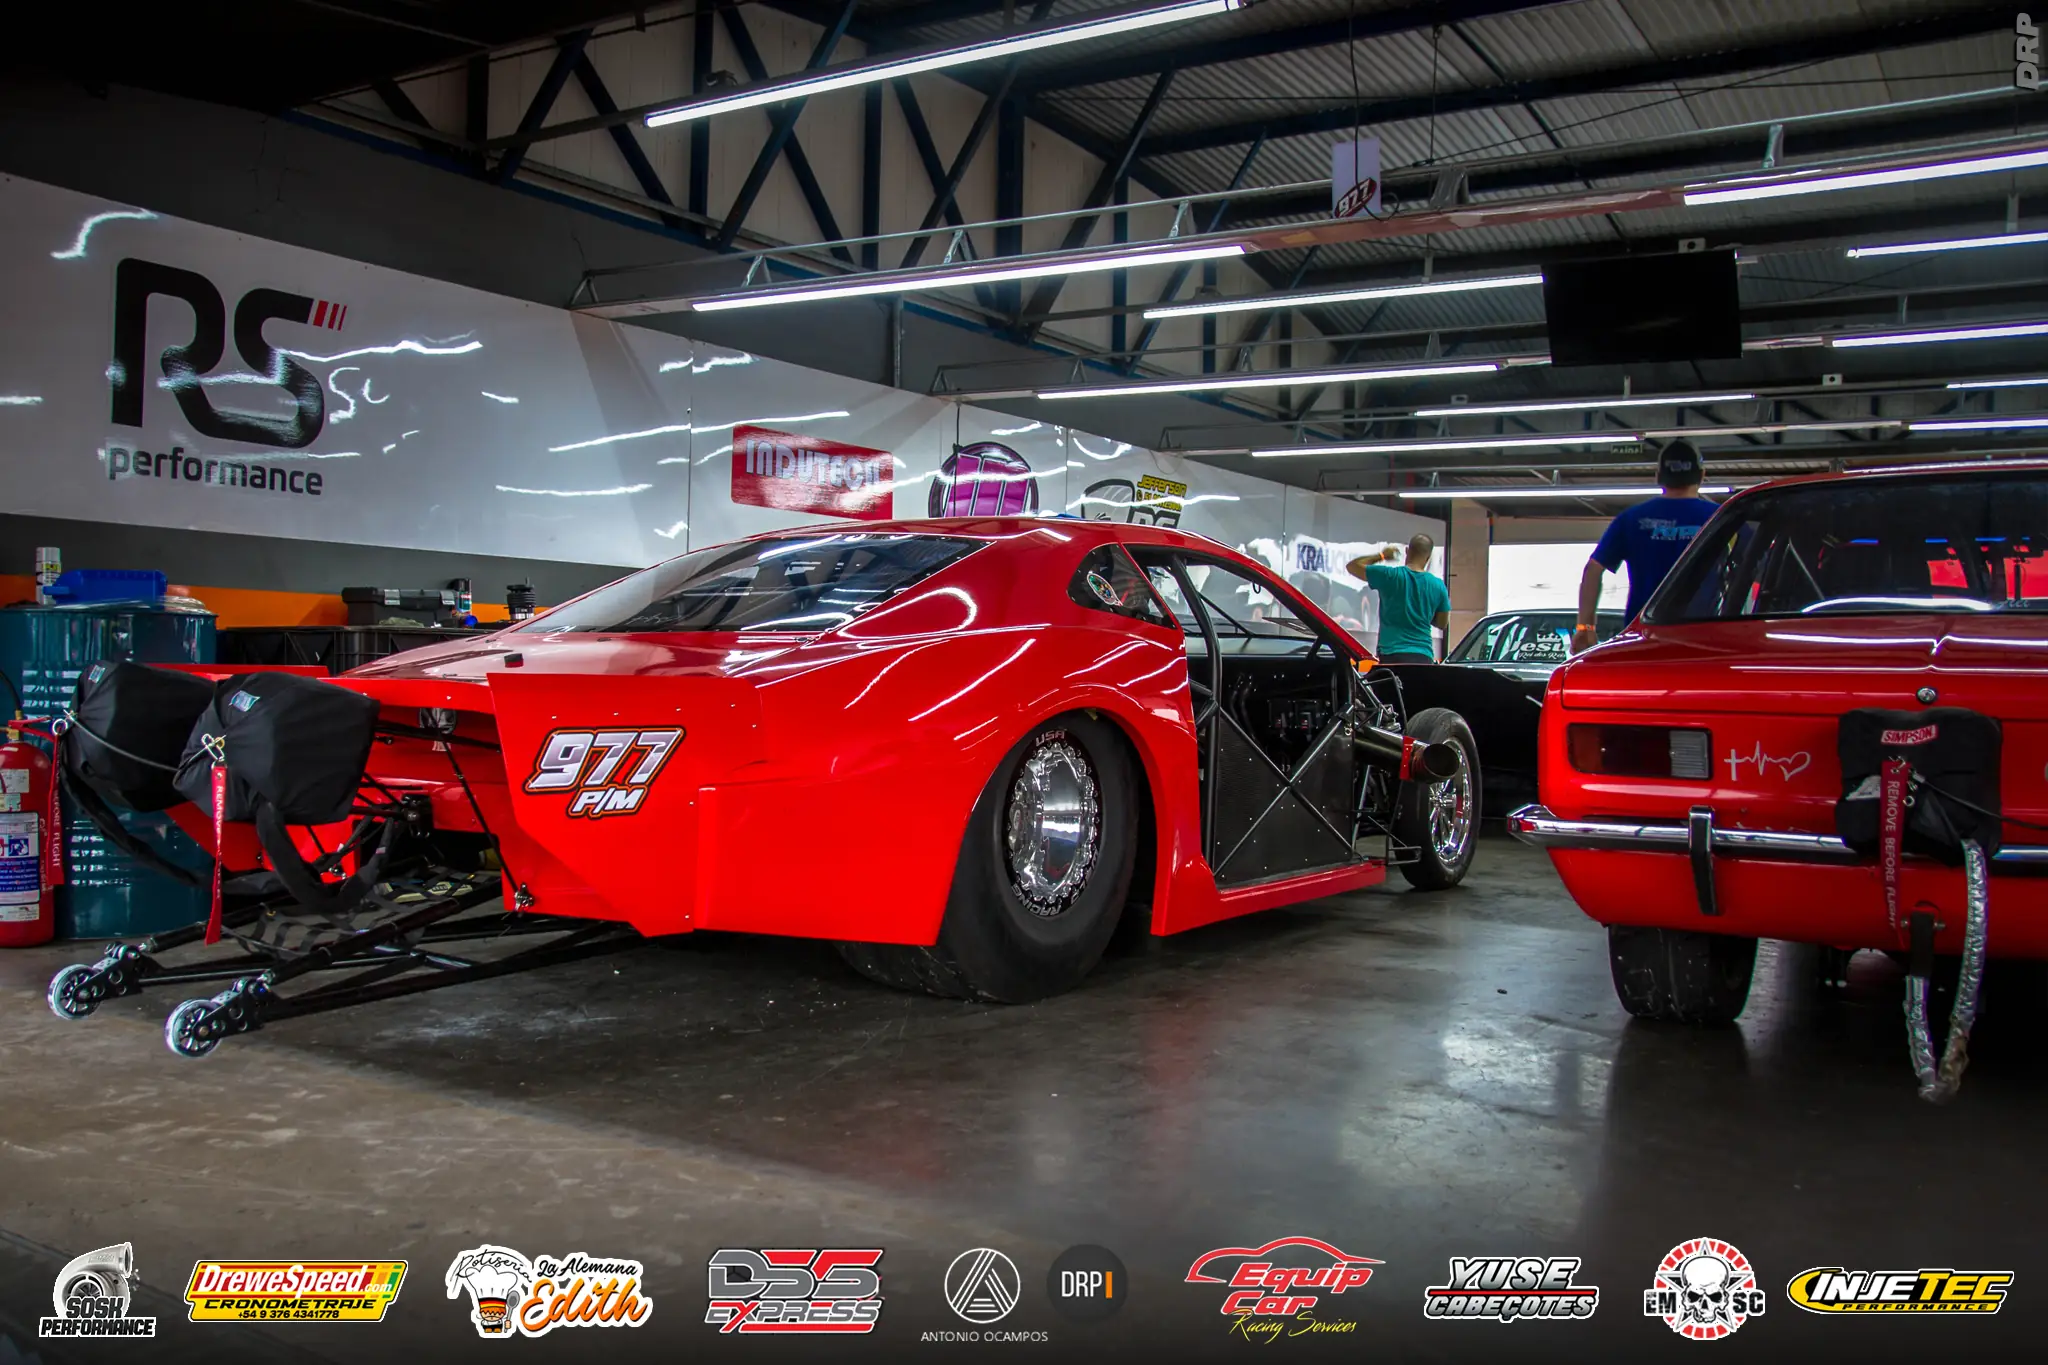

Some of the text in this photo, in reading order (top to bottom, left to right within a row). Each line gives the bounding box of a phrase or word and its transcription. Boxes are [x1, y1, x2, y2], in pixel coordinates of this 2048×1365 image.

[111, 257, 325, 449] RS
[108, 446, 323, 496] performance
[1035, 729, 1065, 747] USA
[1883, 726, 1934, 744] SIMPSON
[526, 729, 684, 790] 977
[571, 787, 645, 814] P/M
[52, 831, 61, 867] FLIGHT
[1885, 780, 1900, 928] REMOVE BEFORE FLIGHT
[1011, 884, 1062, 916] RACING
